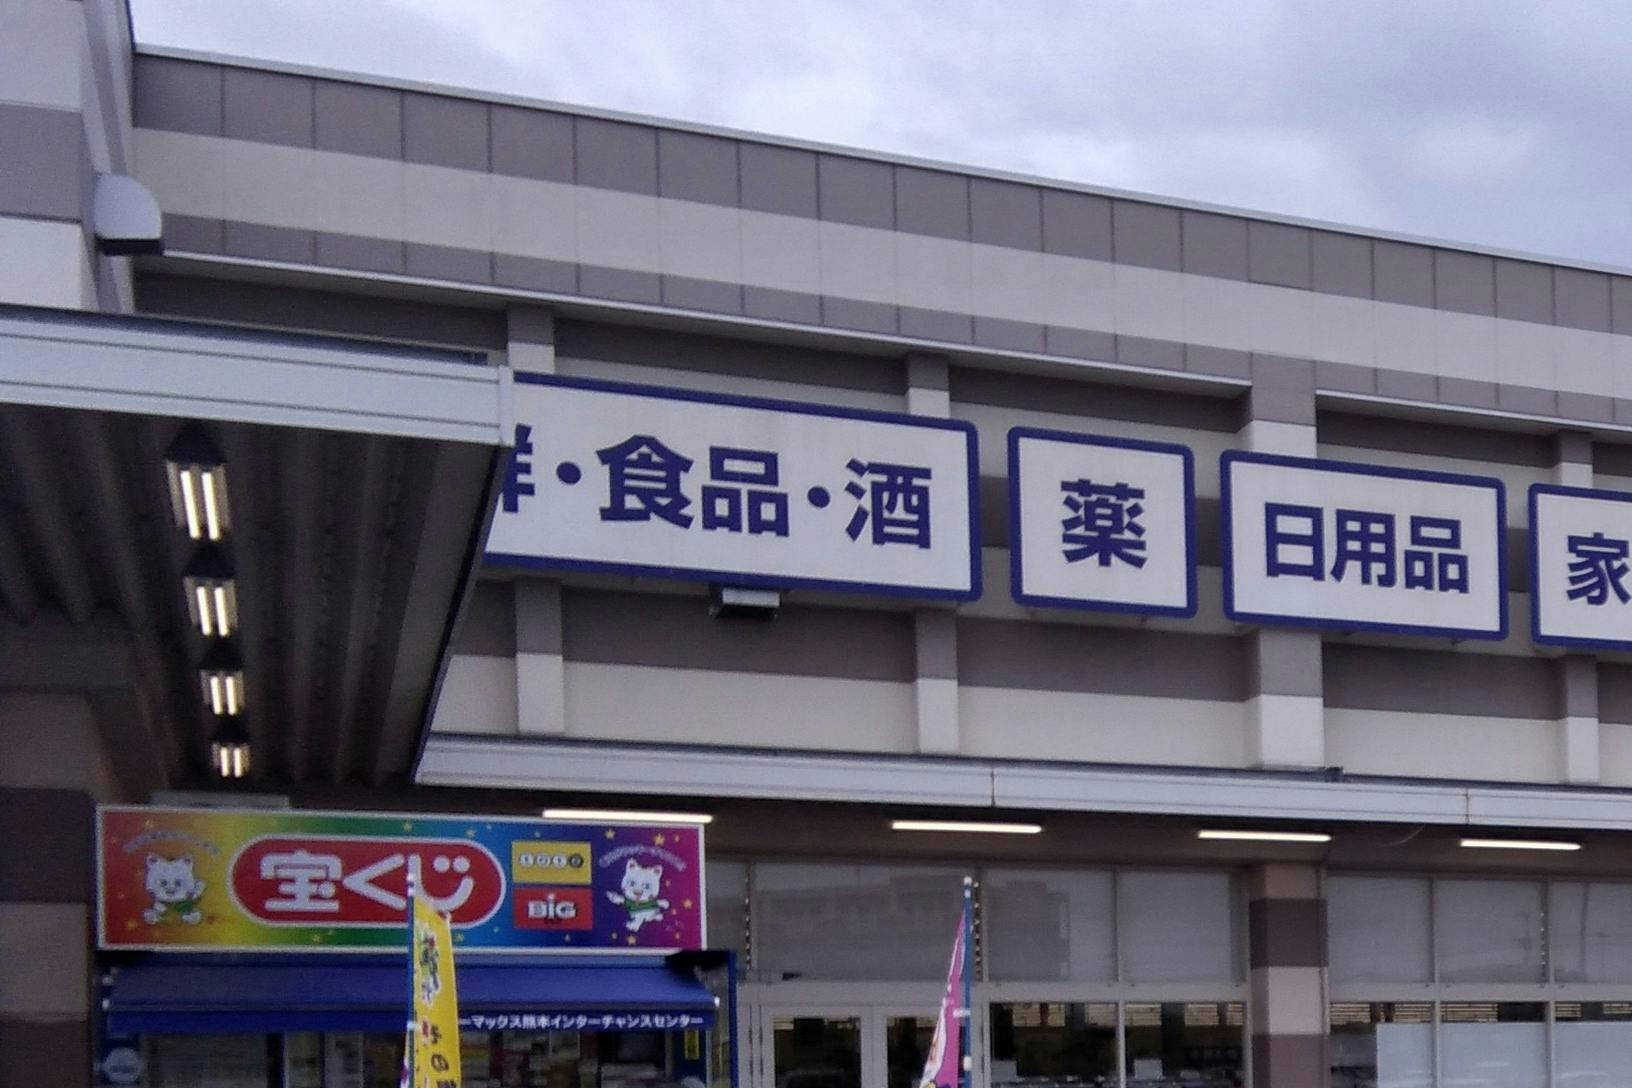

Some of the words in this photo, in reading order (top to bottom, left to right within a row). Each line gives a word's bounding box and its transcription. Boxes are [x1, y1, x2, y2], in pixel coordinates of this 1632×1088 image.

[1061, 479, 1147, 569] 薬
[1264, 501, 1469, 594] 日用品
[260, 849, 474, 912] 宝くじ
